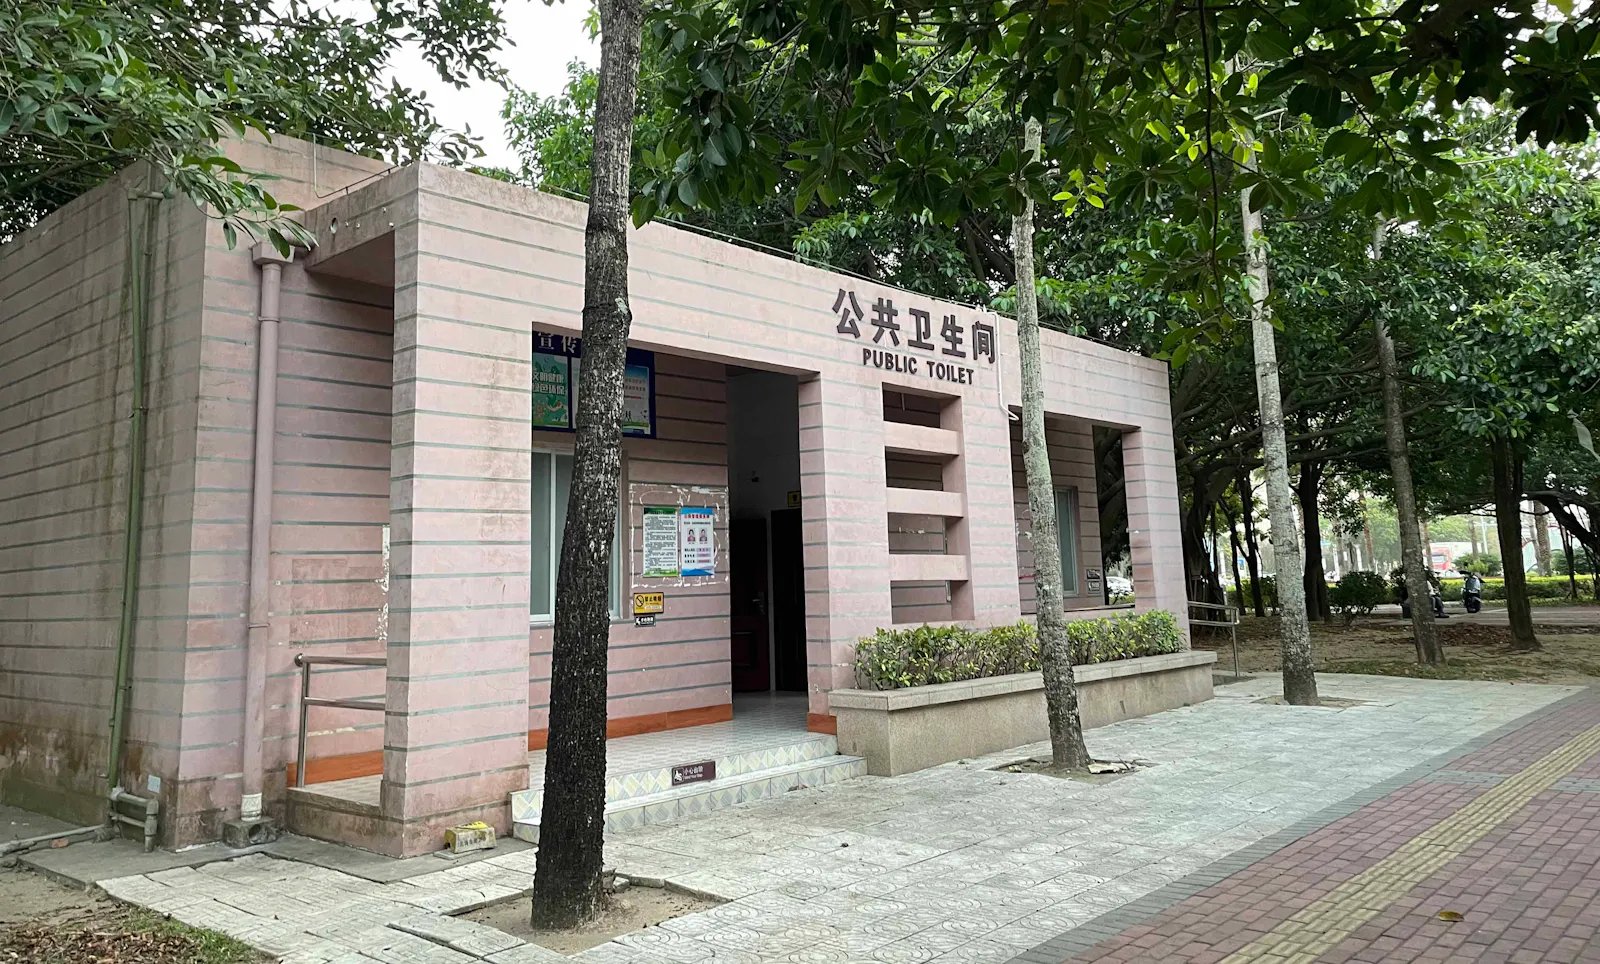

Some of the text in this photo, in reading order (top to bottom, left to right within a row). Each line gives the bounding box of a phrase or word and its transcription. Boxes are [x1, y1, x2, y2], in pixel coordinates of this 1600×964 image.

[832, 288, 995, 364] 公共卫生间
[862, 348, 974, 385] PUBLIC TOILET
